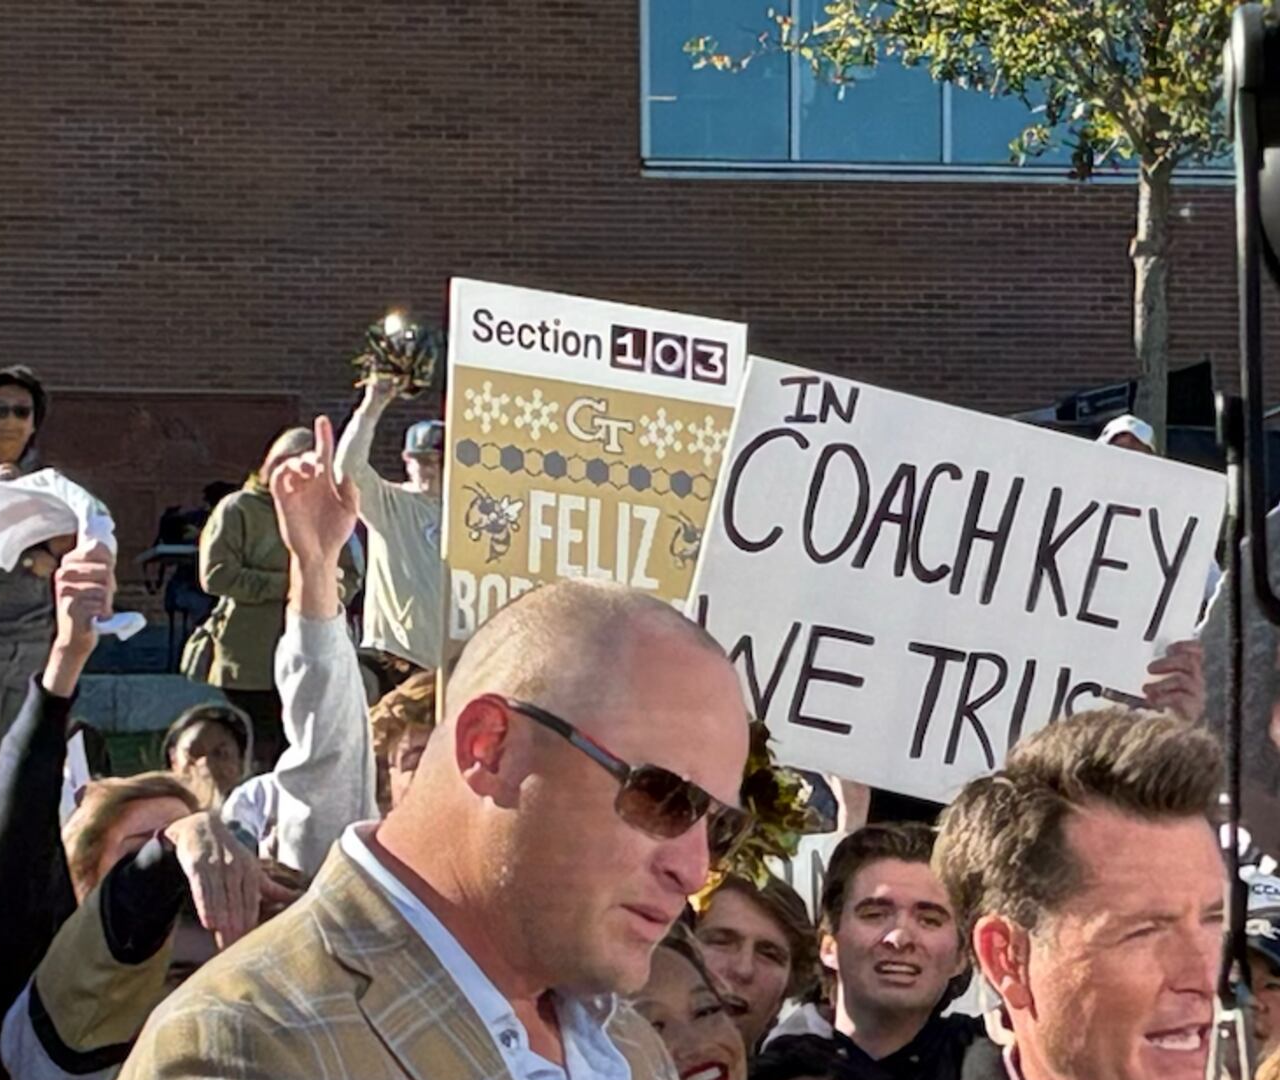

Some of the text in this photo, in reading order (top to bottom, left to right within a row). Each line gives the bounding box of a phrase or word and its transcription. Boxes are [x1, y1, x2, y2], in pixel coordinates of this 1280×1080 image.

[472, 308, 728, 381] Section 103
[780, 376, 861, 425] IN
[527, 490, 662, 590] FELIZ
[722, 427, 1025, 605] COACH
[1025, 486, 1200, 642] KEY
